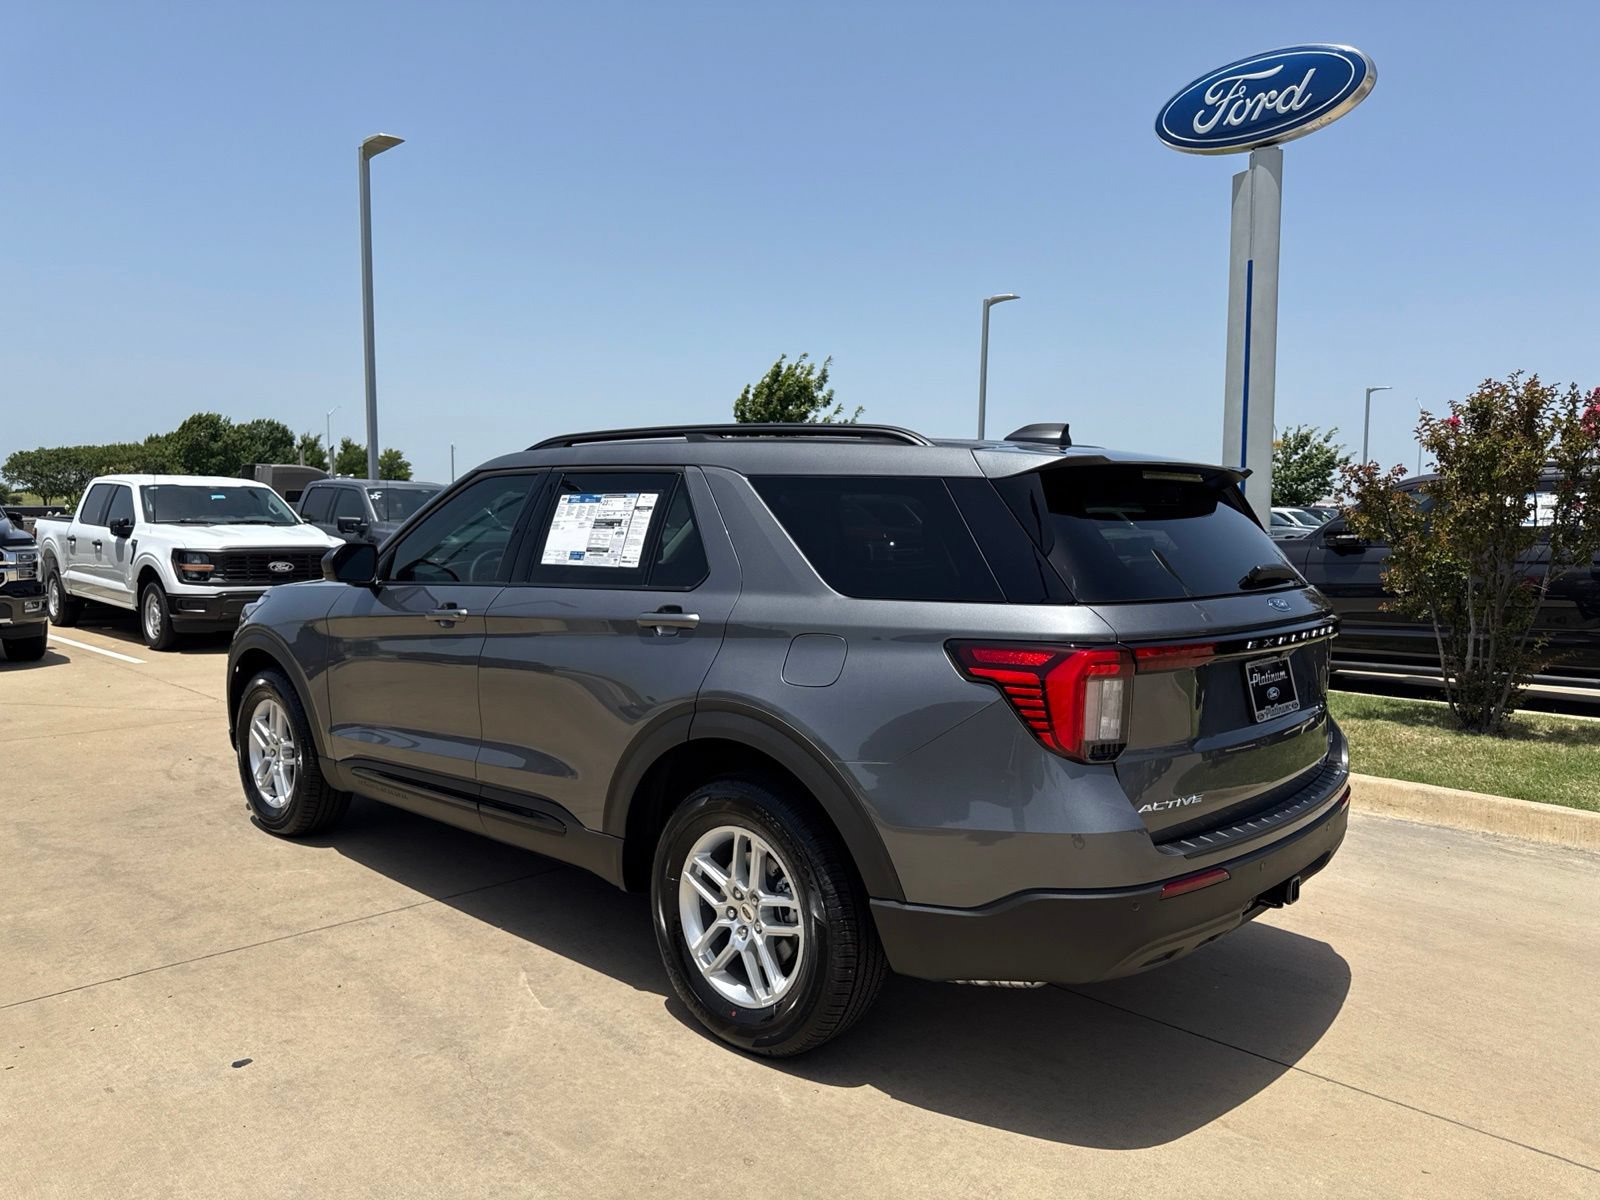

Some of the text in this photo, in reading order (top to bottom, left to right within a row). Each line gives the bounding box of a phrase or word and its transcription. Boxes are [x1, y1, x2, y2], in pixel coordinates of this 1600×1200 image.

[1193, 64, 1316, 134] Ford
[1250, 670, 1288, 687] Platinum
[1137, 794, 1204, 813] ACTIVE
